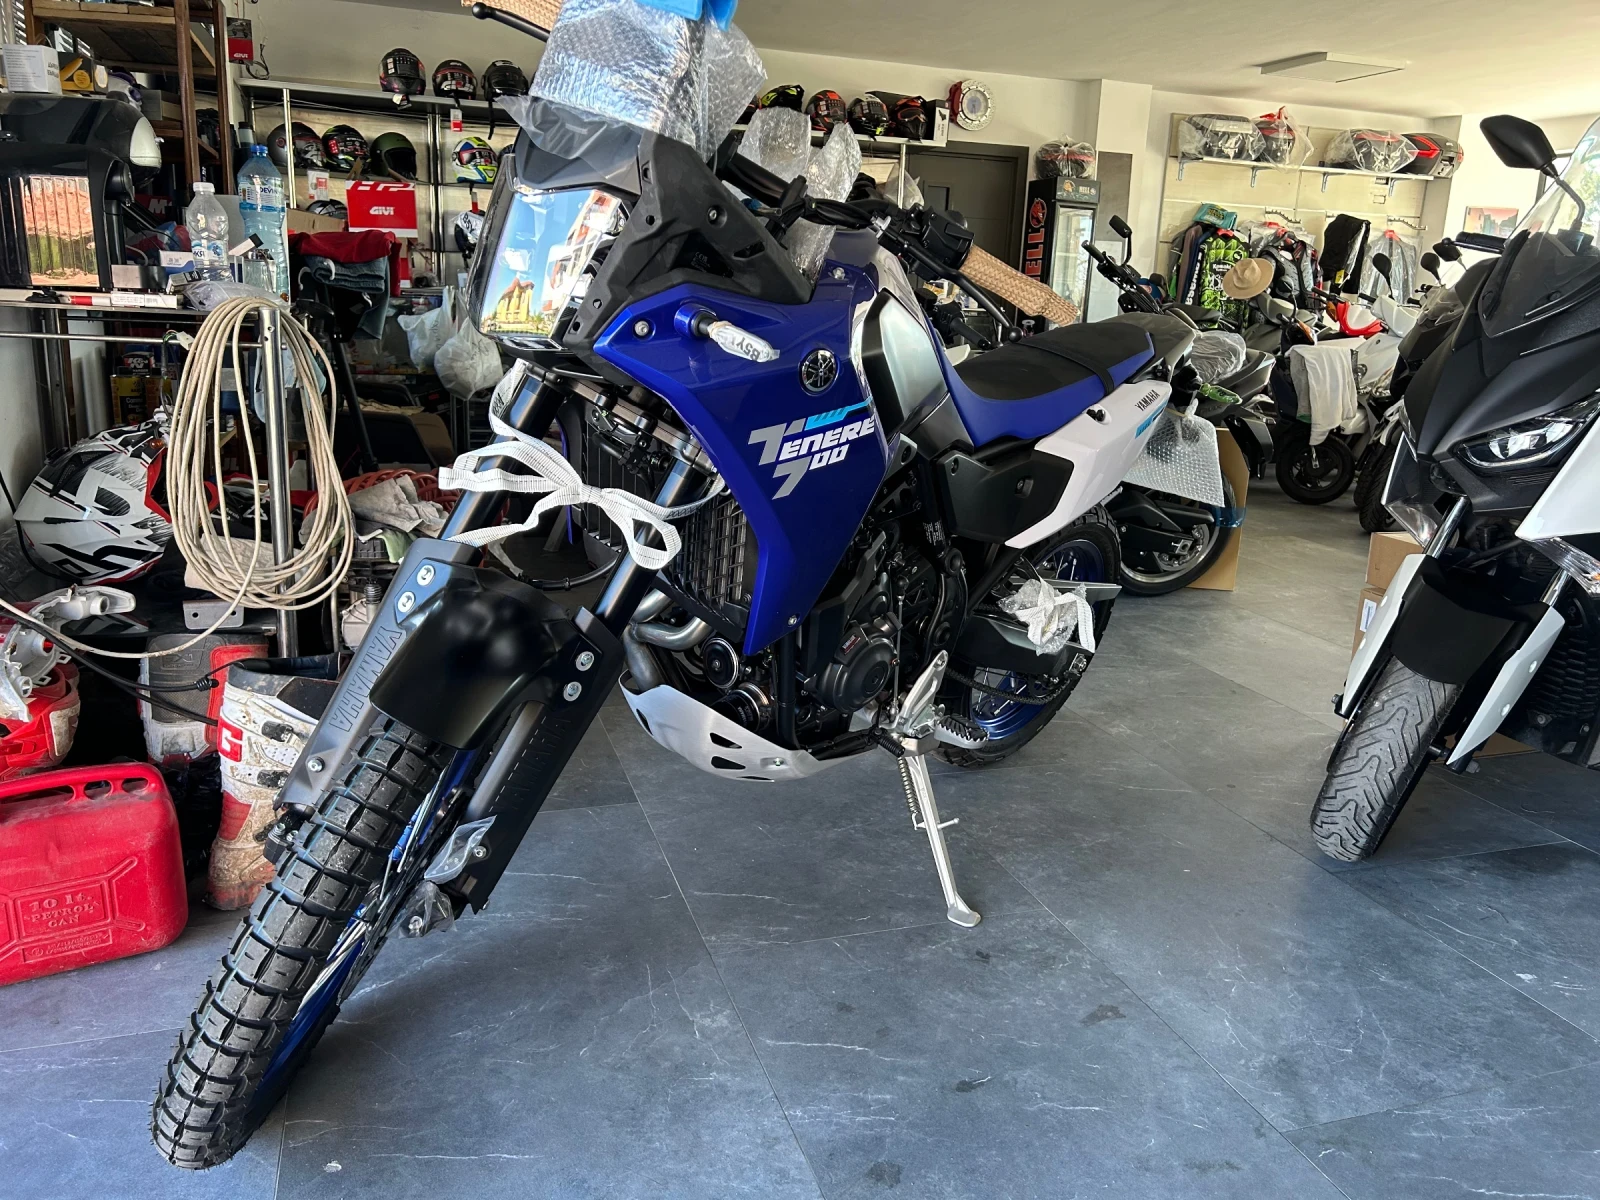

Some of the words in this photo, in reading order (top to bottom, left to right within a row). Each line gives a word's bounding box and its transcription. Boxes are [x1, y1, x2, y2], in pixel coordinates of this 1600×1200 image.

[369, 206, 395, 216] GIVI
[1134, 389, 1161, 412] YAMAHA
[772, 443, 850, 500] 700
[328, 625, 403, 733] YAMAHA
[29, 898, 58, 912] 10
[31, 902, 94, 922] PETROL
[48, 914, 80, 928] CAN
